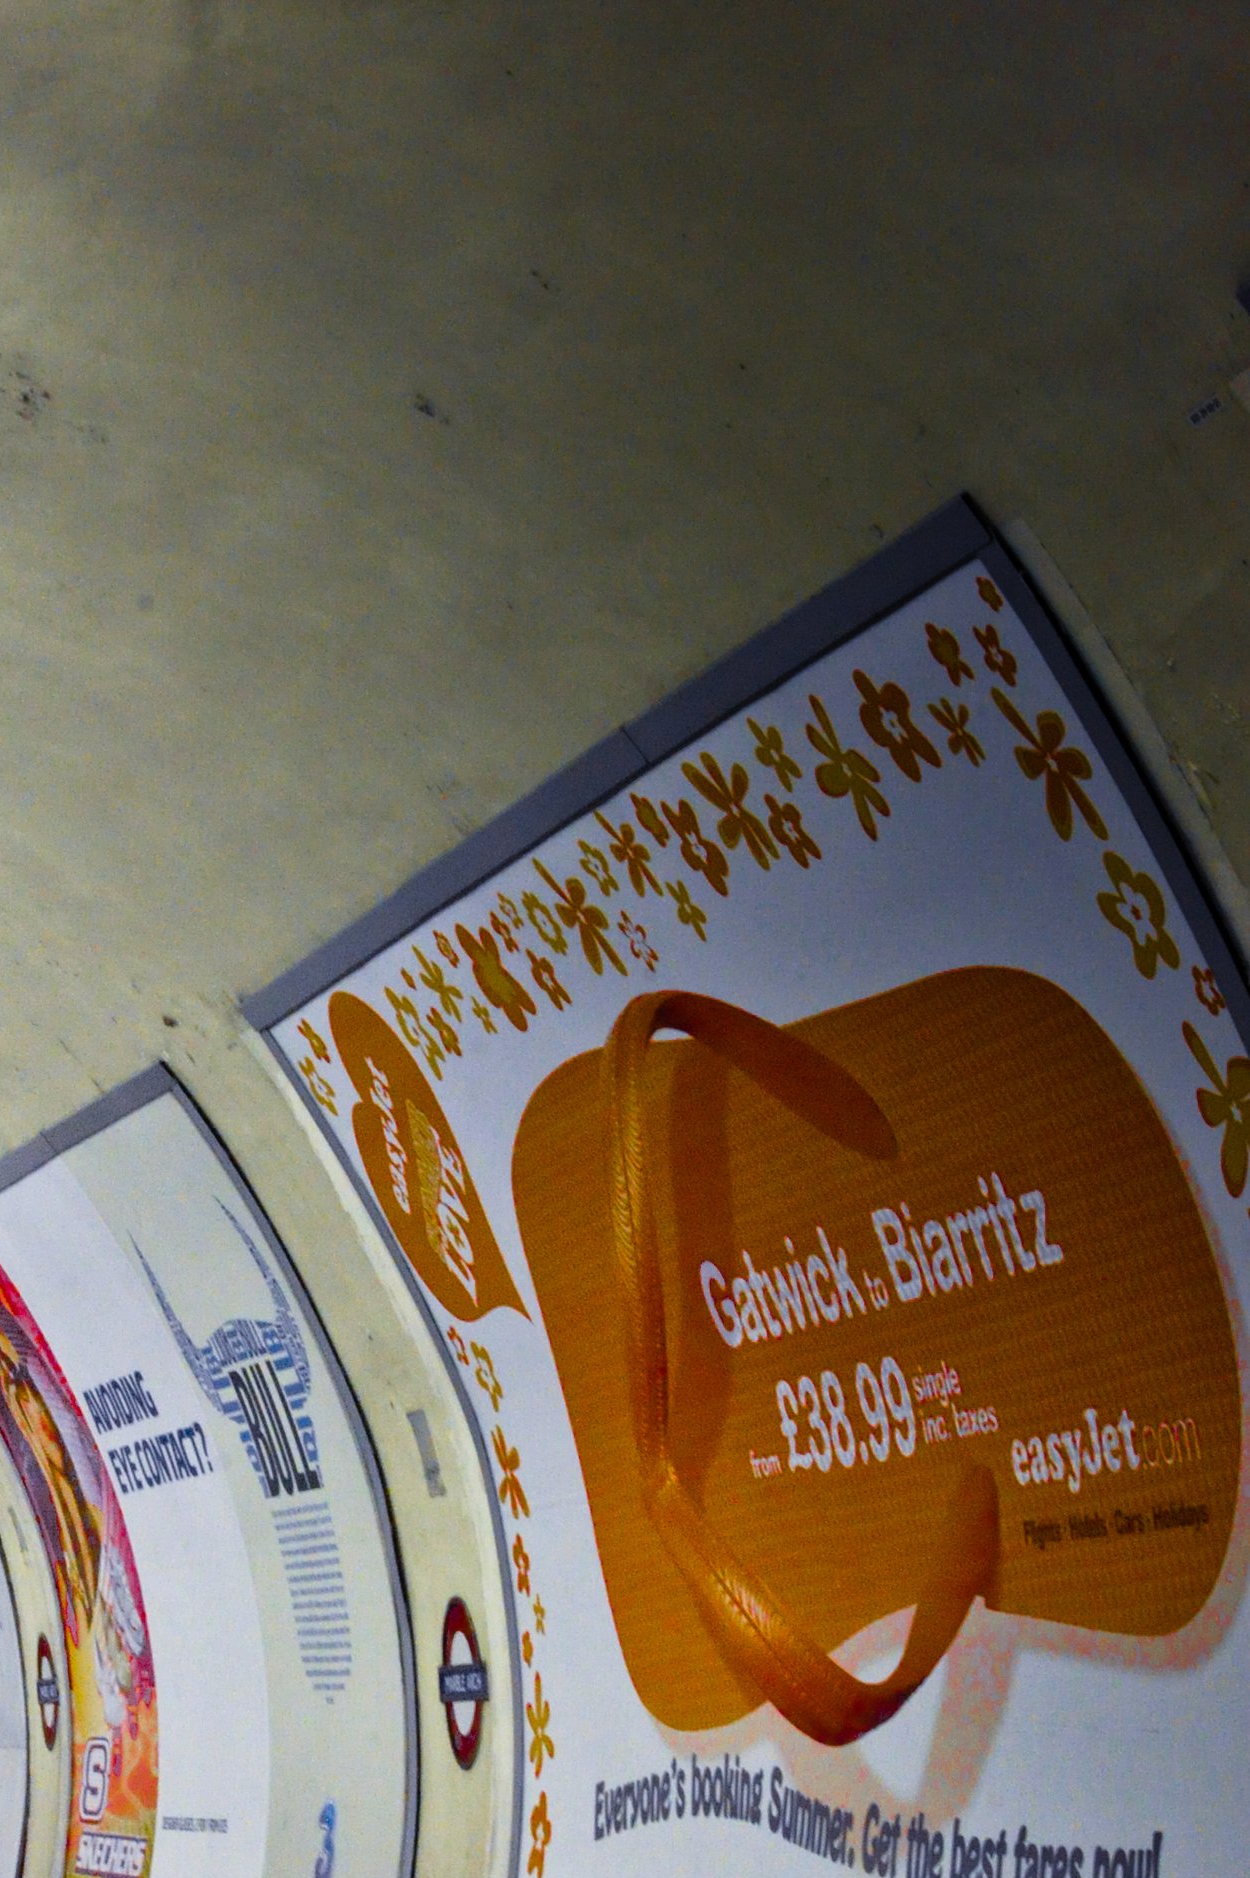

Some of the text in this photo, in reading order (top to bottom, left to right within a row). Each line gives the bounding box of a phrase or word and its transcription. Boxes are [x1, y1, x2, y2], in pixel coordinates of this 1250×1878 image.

[699, 1171, 1064, 1348] Gatwick to Biarritz
[83, 1370, 159, 1435] AVOIDING
[749, 1355, 917, 1479] from £38.99
[911, 1360, 962, 1408] single
[918, 1402, 999, 1445] inc. taxes
[107, 1421, 213, 1494] EYE CONTACT?
[228, 1360, 321, 1497] BULL
[1011, 1408, 1202, 1494] easyJet.com
[594, 1757, 686, 1841] Everyone's
[688, 1753, 764, 1825] booking
[769, 1766, 855, 1869] Summer.
[862, 1803, 901, 1878] Get
